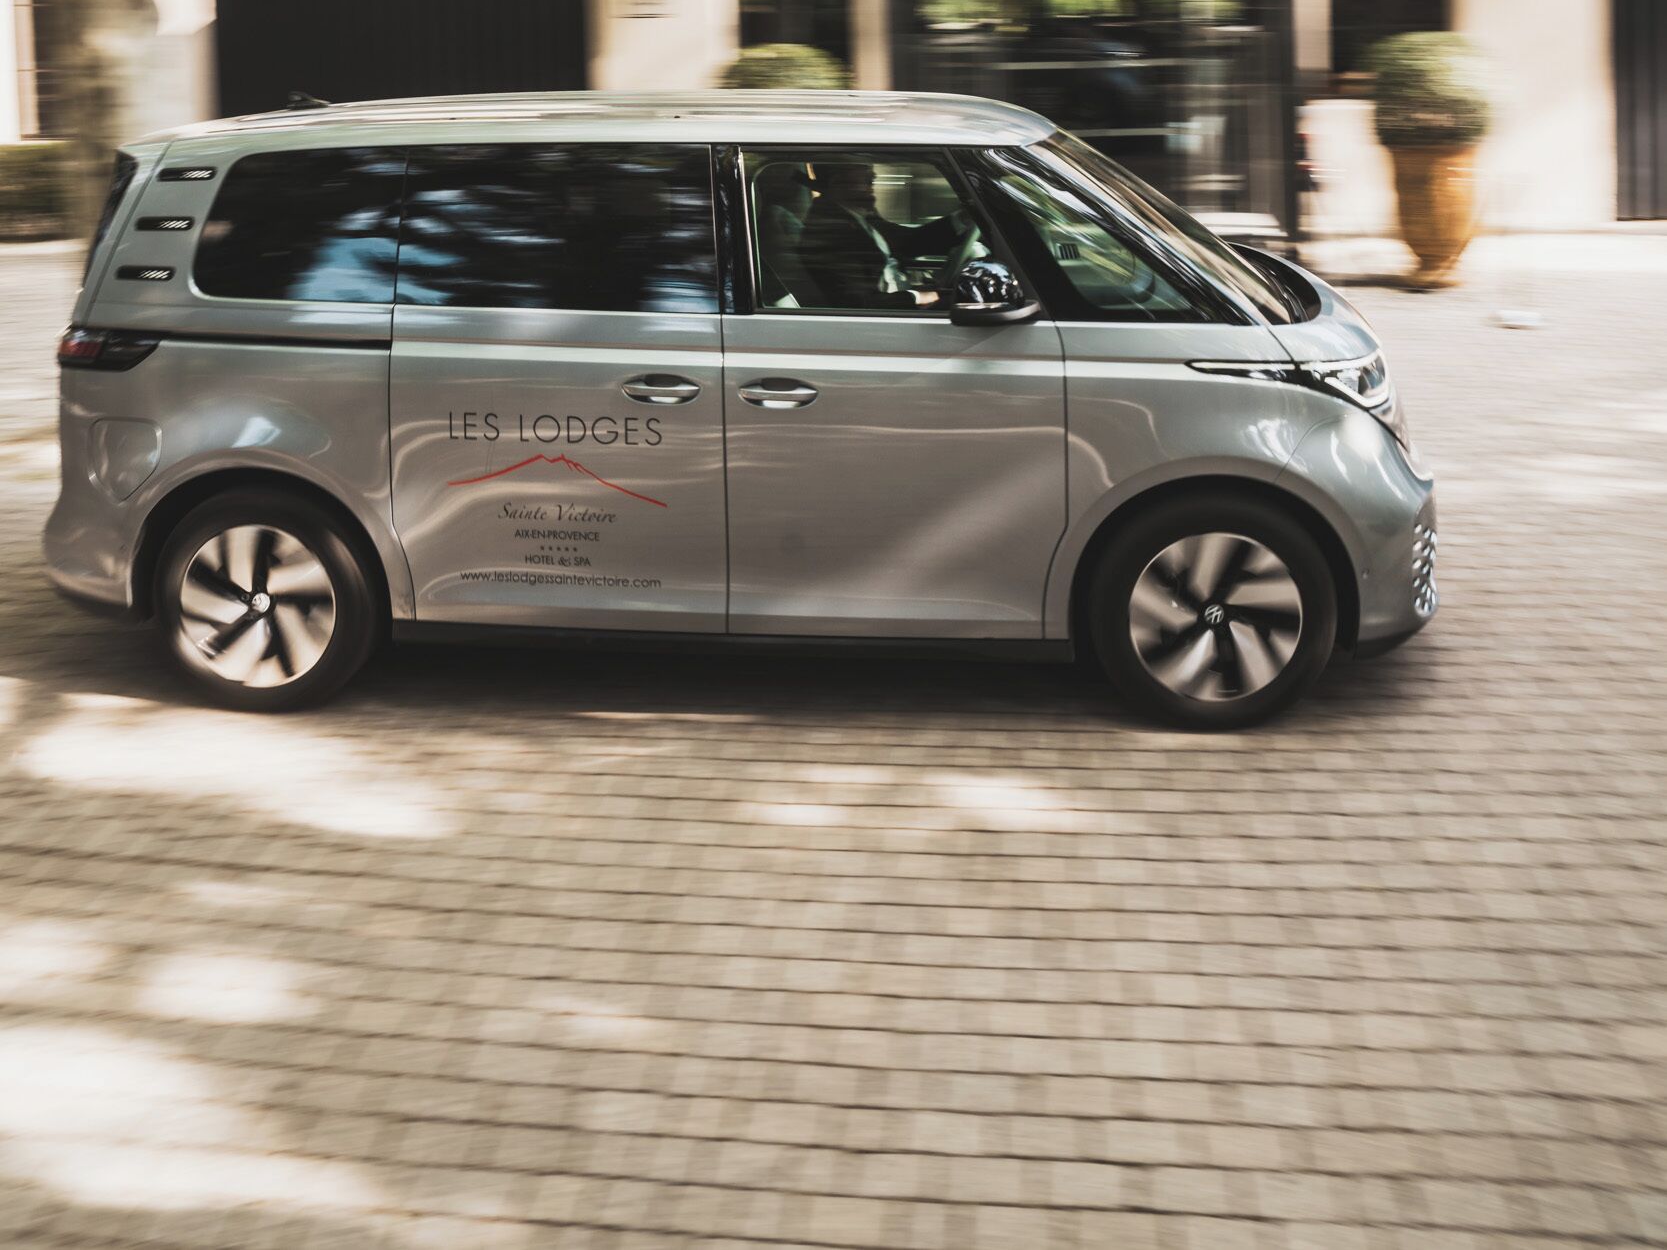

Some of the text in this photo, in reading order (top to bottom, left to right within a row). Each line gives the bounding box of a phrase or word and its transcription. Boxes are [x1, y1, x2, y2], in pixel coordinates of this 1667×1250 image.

[449, 411, 663, 447] LES LODGES
[498, 502, 617, 524] Sainte Victoire
[525, 554, 555, 566] HOTEL
[574, 556, 592, 567] SPA
[460, 571, 661, 588] www.leslodgessaintevictoire.com
